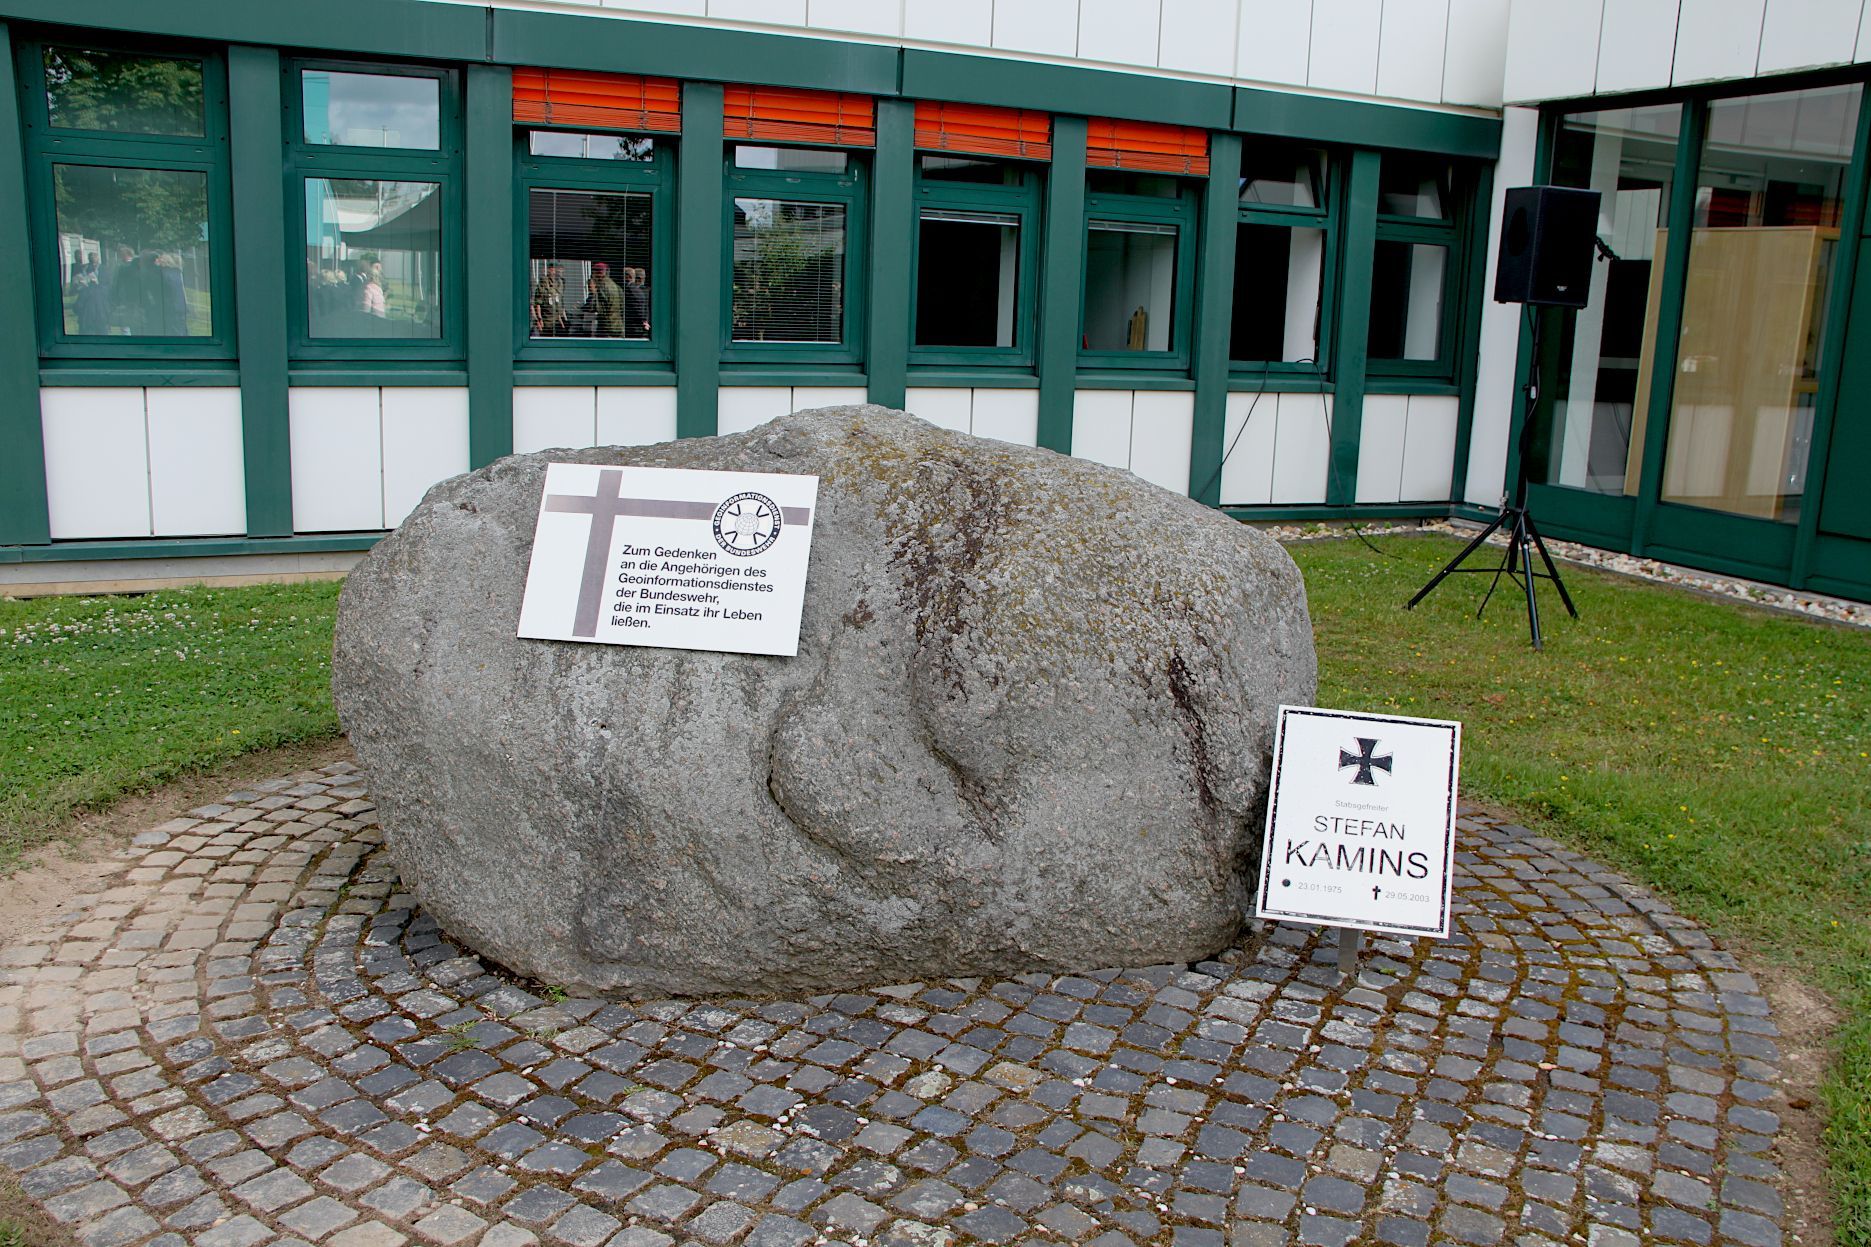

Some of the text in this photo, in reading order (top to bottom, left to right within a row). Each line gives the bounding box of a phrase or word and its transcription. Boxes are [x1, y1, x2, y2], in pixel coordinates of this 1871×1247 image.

[623, 544, 717, 560] Zum Gedenken
[620, 560, 767, 577] an die Angehörigen des
[618, 573, 773, 592] Geoinformationsdienstes
[615, 587, 720, 605] der Bundeswehr,
[613, 602, 762, 621] die im Einsatz ihr Leben
[611, 616, 651, 628] ließen.
[1335, 800, 1389, 812] Stabsgefreiter
[1313, 815, 1405, 840] STEFAN
[1286, 839, 1428, 879] KAMINS
[1298, 882, 1430, 903] 23.01.1975 29.05.2003
